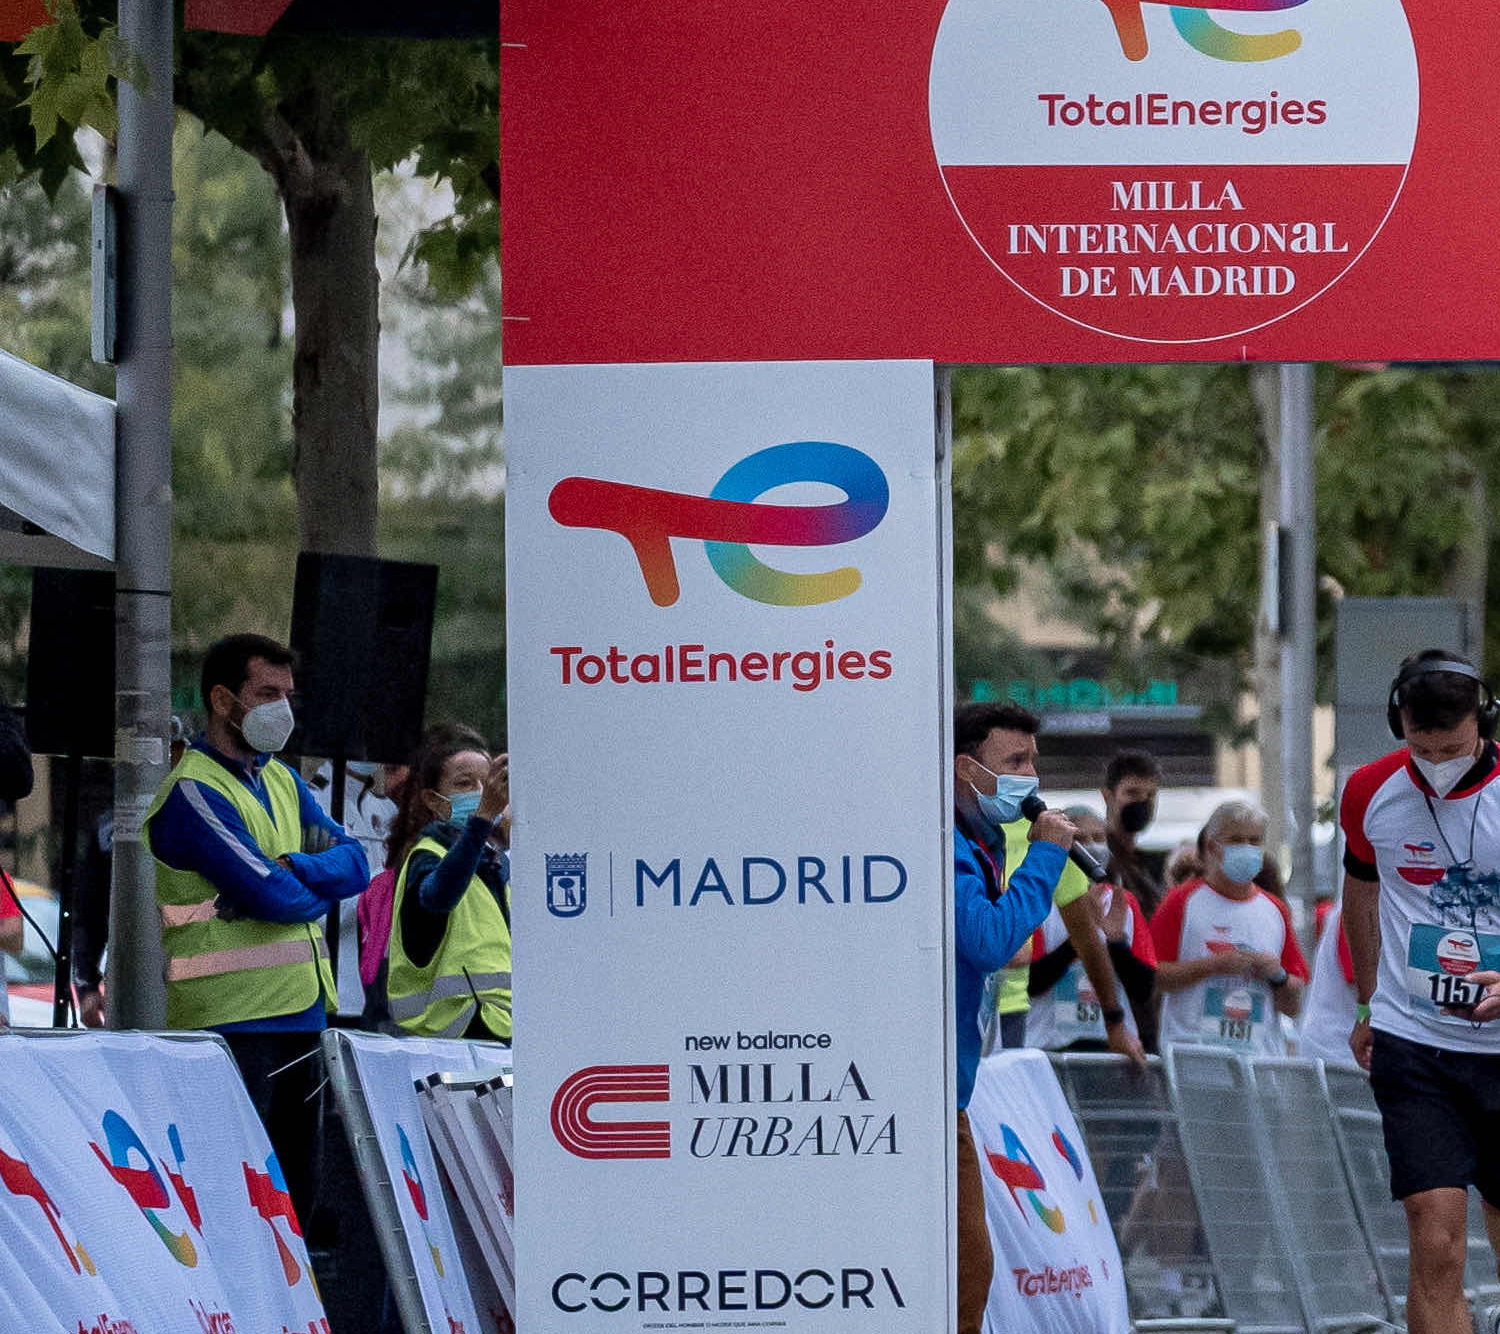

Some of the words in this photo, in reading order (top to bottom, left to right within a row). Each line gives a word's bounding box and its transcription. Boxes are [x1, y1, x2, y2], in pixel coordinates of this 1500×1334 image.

[1037, 91, 1328, 135] TotalEnergies
[1110, 180, 1245, 211] MILLA
[1060, 266, 1119, 298] DE
[1128, 265, 1297, 299] MADRID
[550, 640, 893, 692] TotalEnergies
[635, 855, 908, 907] MADRID
[684, 1034, 732, 1052] new
[735, 1030, 833, 1051] balance
[687, 1060, 874, 1104] MILLA
[689, 1113, 902, 1159] URBANA
